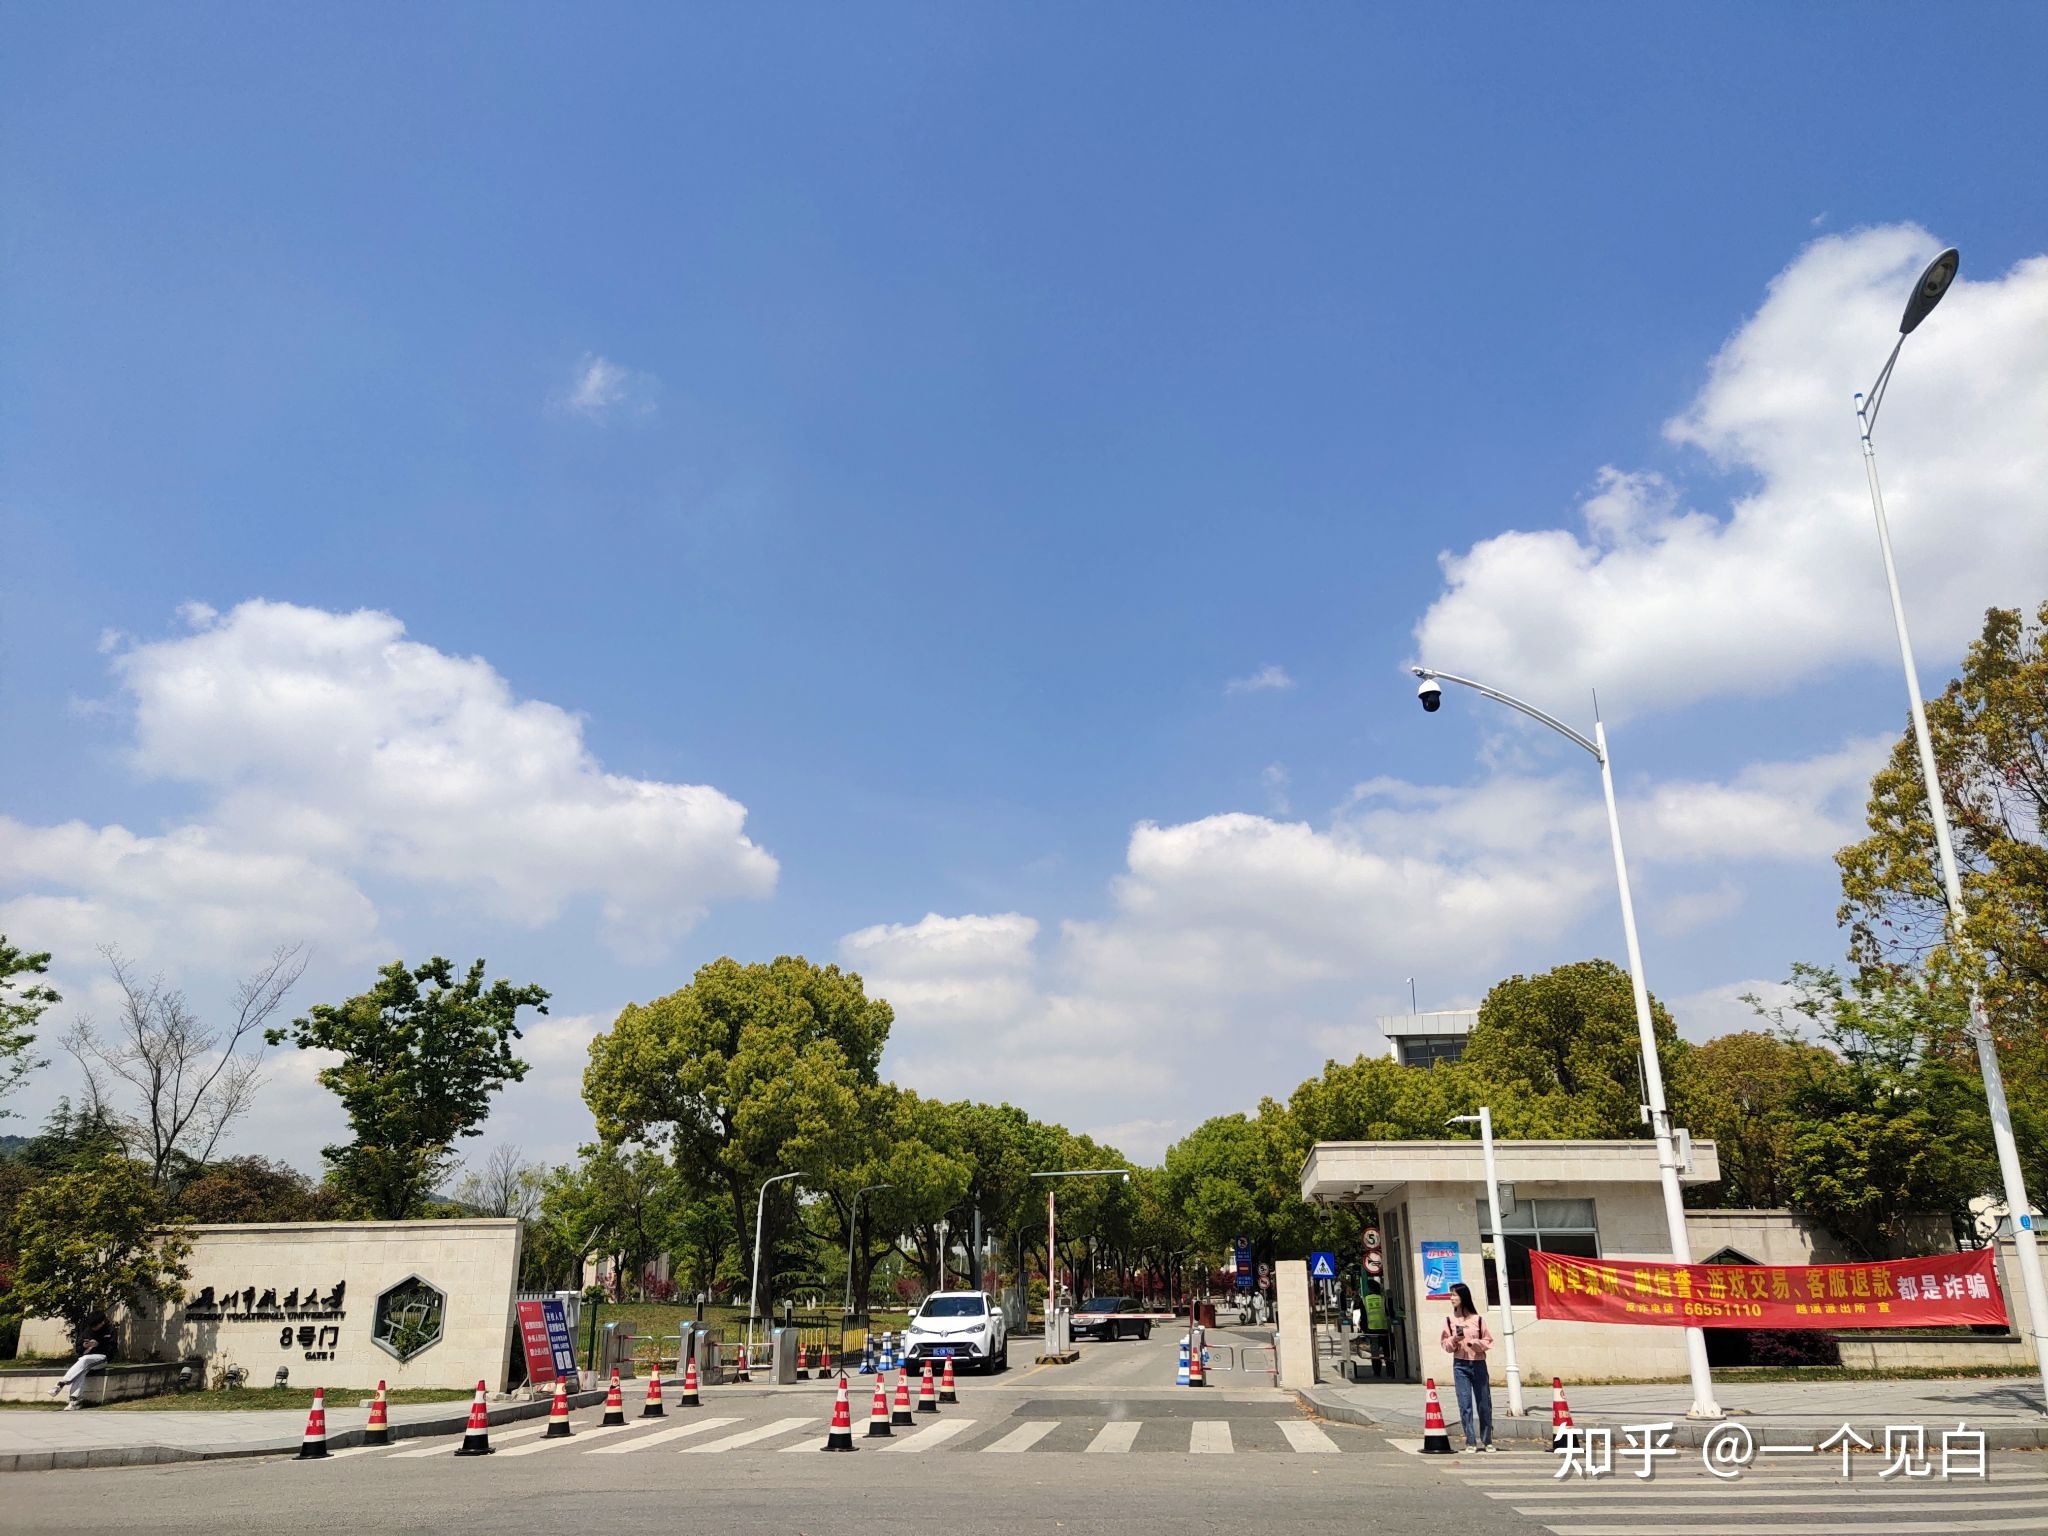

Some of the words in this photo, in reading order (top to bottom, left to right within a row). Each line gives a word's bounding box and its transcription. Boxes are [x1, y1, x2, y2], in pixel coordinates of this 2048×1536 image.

[1367, 1233, 1376, 1245] 5
[1625, 1303, 1674, 1315] 反诈电话
[1684, 1303, 1762, 1317] 66551110
[1878, 1302, 1891, 1313] 宣
[227, 1312, 286, 1322] VOCATIONAL
[288, 1311, 346, 1321] UNIVERSITY
[280, 1325, 340, 1347] 8号门
[305, 1351, 328, 1361] GATE
